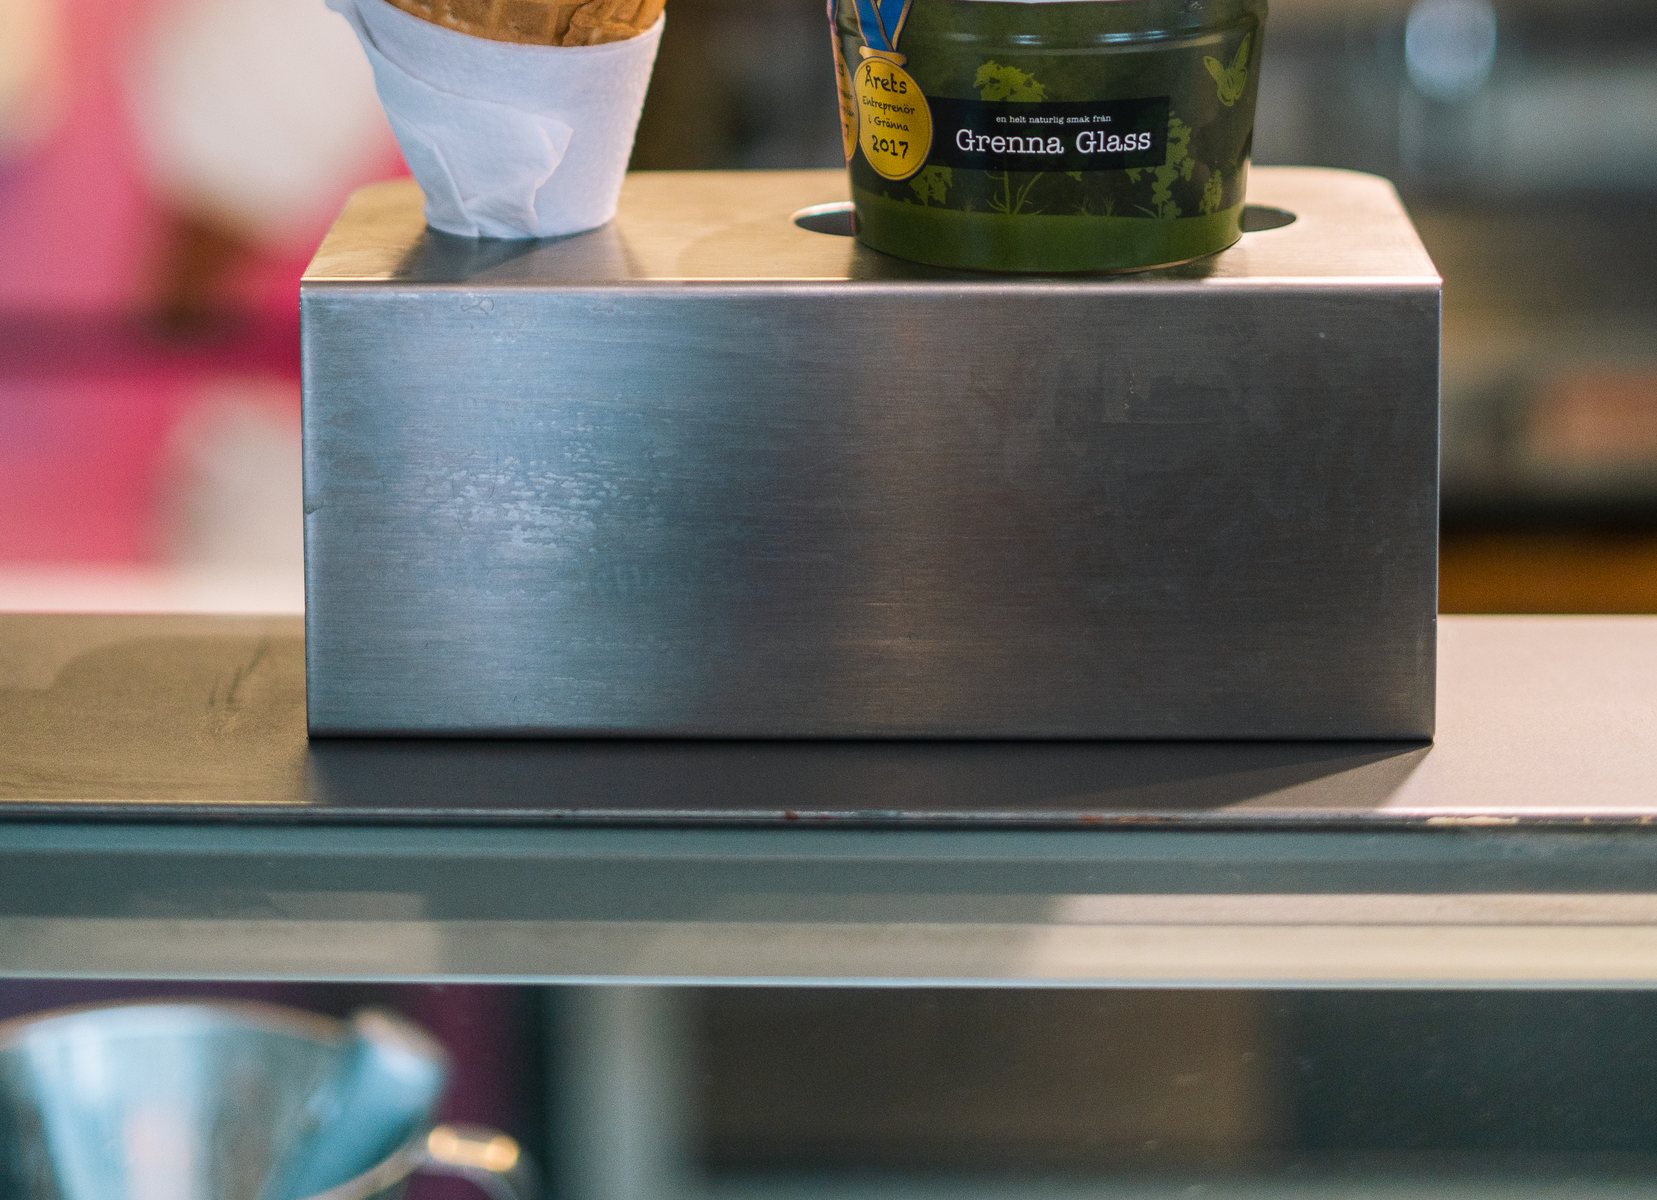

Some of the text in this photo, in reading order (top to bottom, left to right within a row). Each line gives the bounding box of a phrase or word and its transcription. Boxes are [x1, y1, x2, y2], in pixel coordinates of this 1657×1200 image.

[865, 65, 907, 94] Årets
[862, 96, 915, 116] Entreprenör
[874, 116, 910, 132] Gränna
[1009, 115, 1027, 123] helt
[1028, 115, 1064, 125] naturlig
[1066, 115, 1090, 123] smak
[1092, 115, 1112, 123] från
[871, 134, 909, 159] 2017
[955, 128, 1151, 154] Grenna Glass
